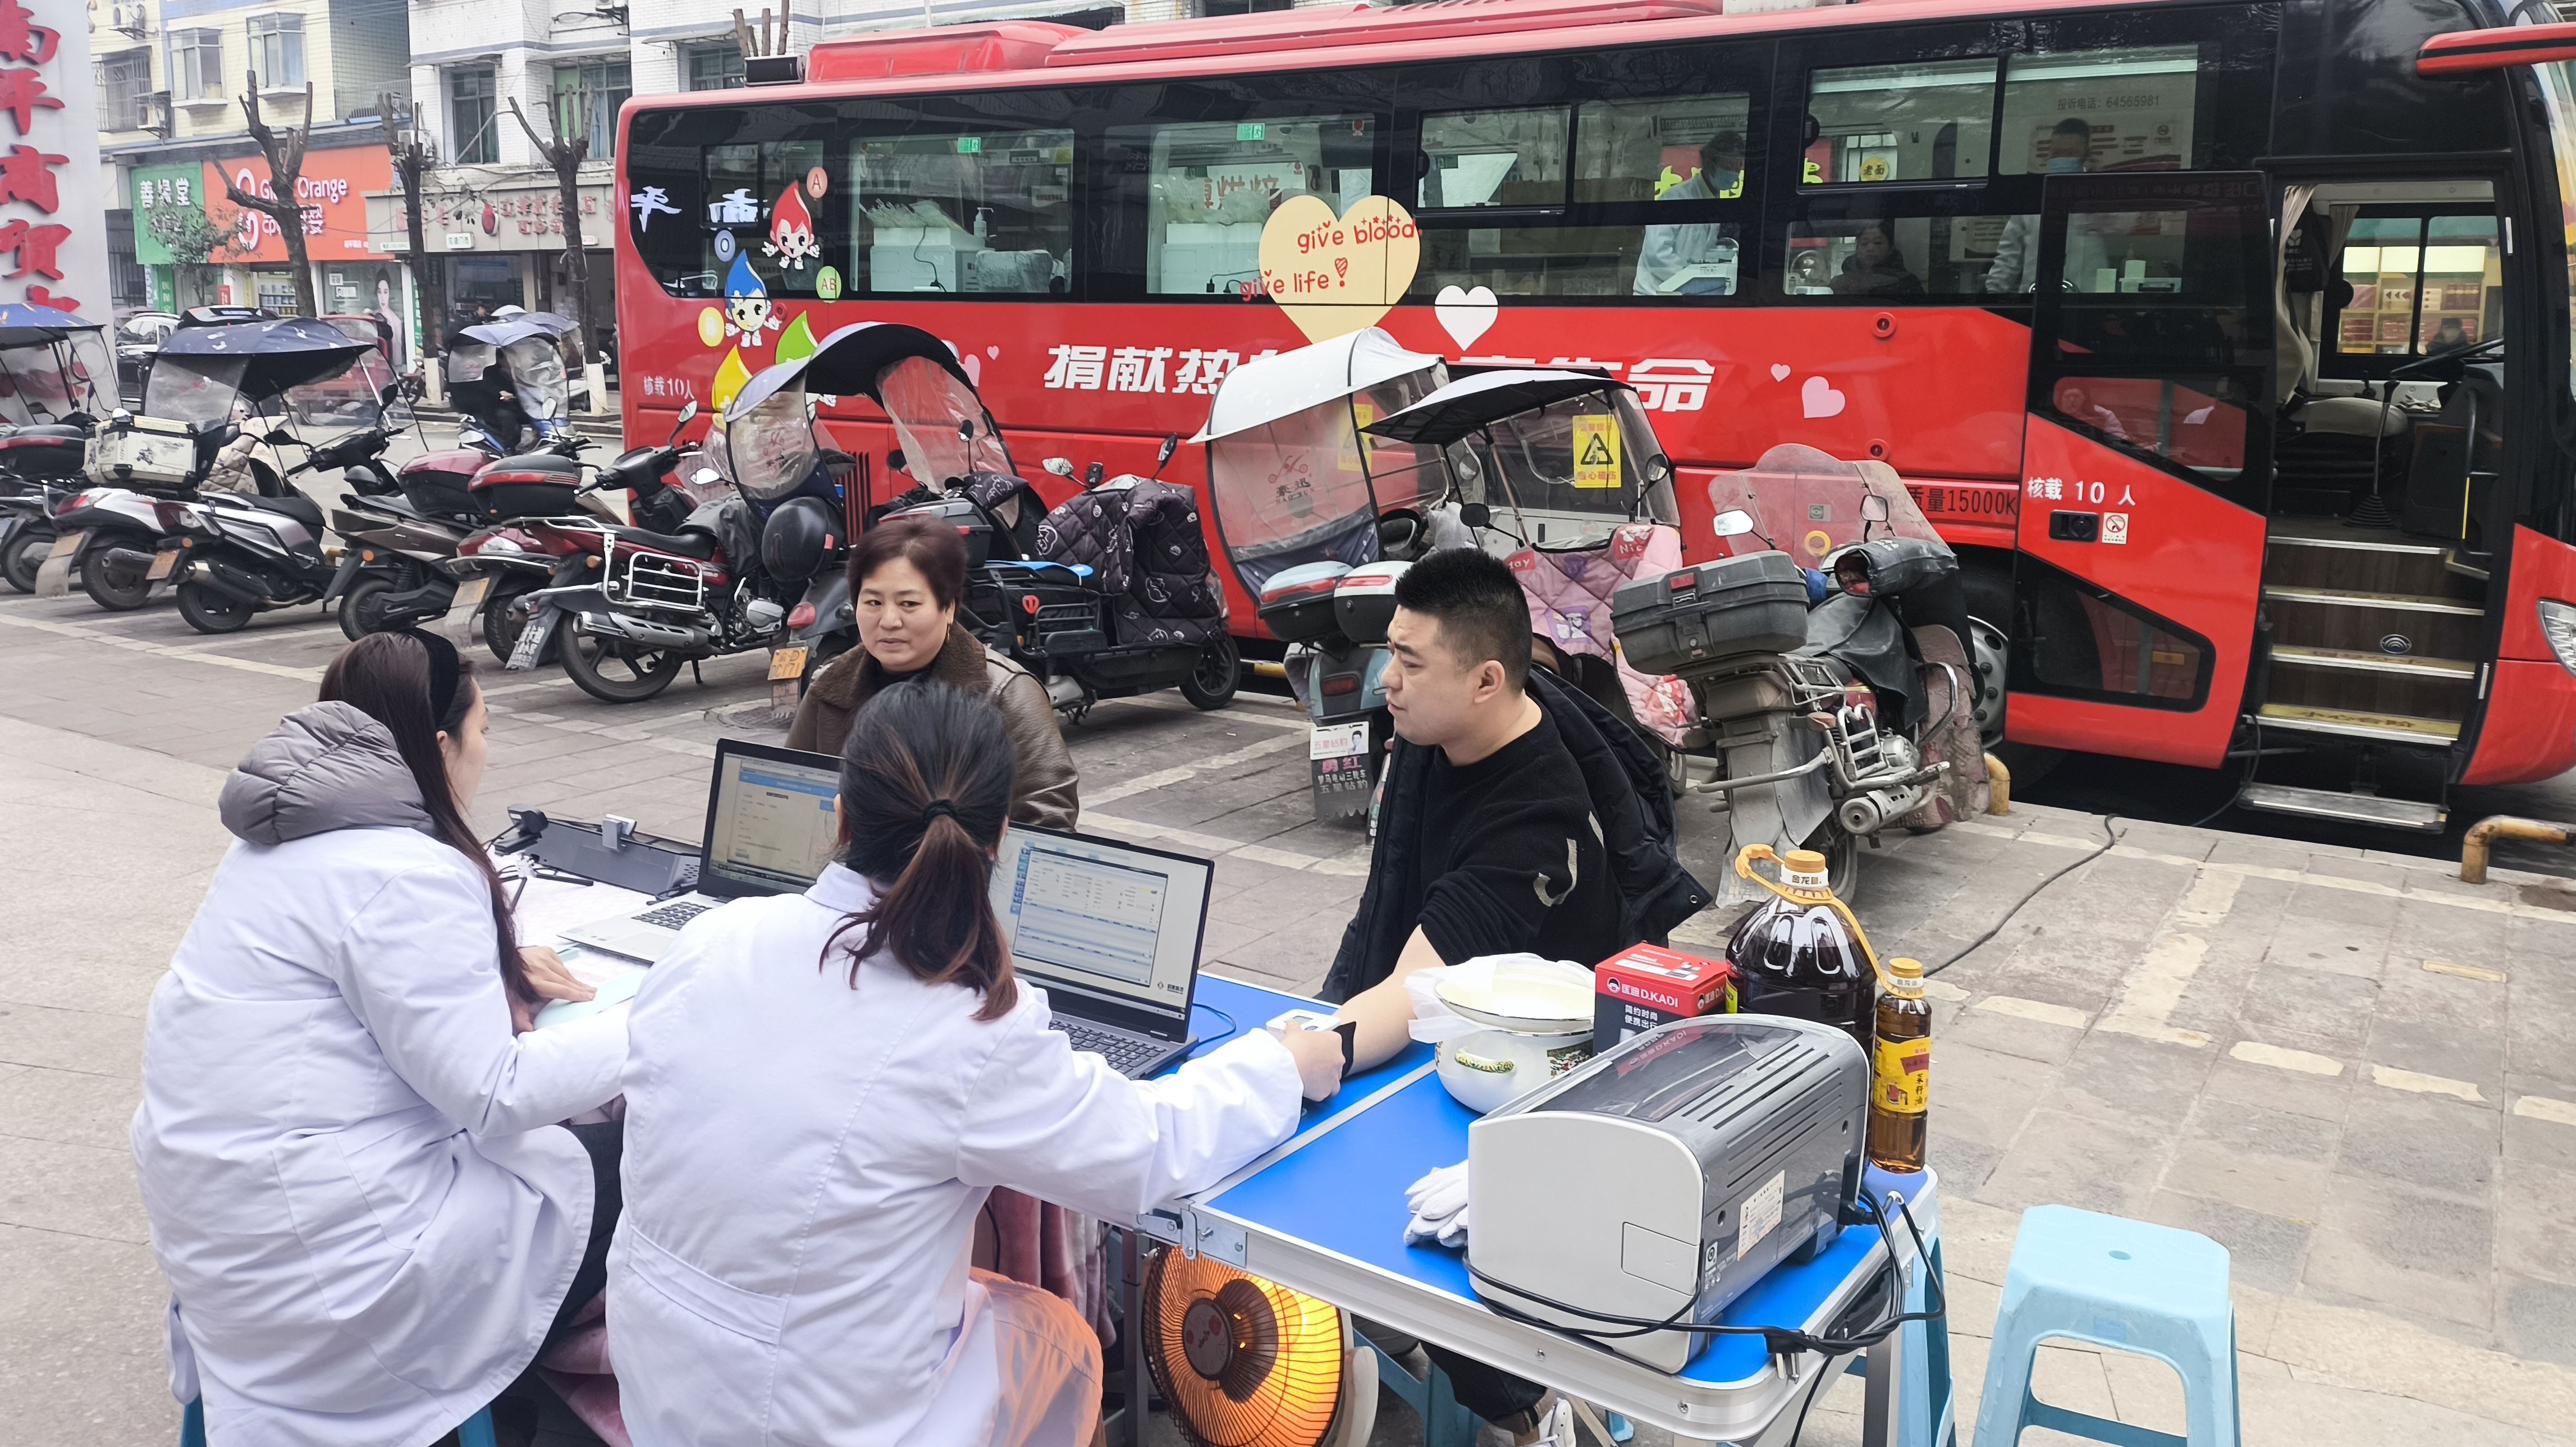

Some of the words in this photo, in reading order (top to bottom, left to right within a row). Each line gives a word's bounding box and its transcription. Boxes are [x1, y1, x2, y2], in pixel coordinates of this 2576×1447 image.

[2106, 95, 2159, 108] 64565981
[1864, 165, 1885, 175] 老面
[813, 174, 821, 190] A
[297, 177, 347, 204] Orange
[1297, 229, 1344, 254] give
[821, 278, 836, 291] AB
[1239, 278, 1284, 301] give
[1043, 344, 1279, 395] 捐献热
[2028, 477, 2063, 500] 核载
[2076, 480, 2105, 503] 10
[2117, 484, 2136, 506] 人
[1792, 874, 1819, 885] 金龙鱼
[1625, 1004, 1658, 1021] 简约时尚
[1625, 1014, 1658, 1029] 便携出行
